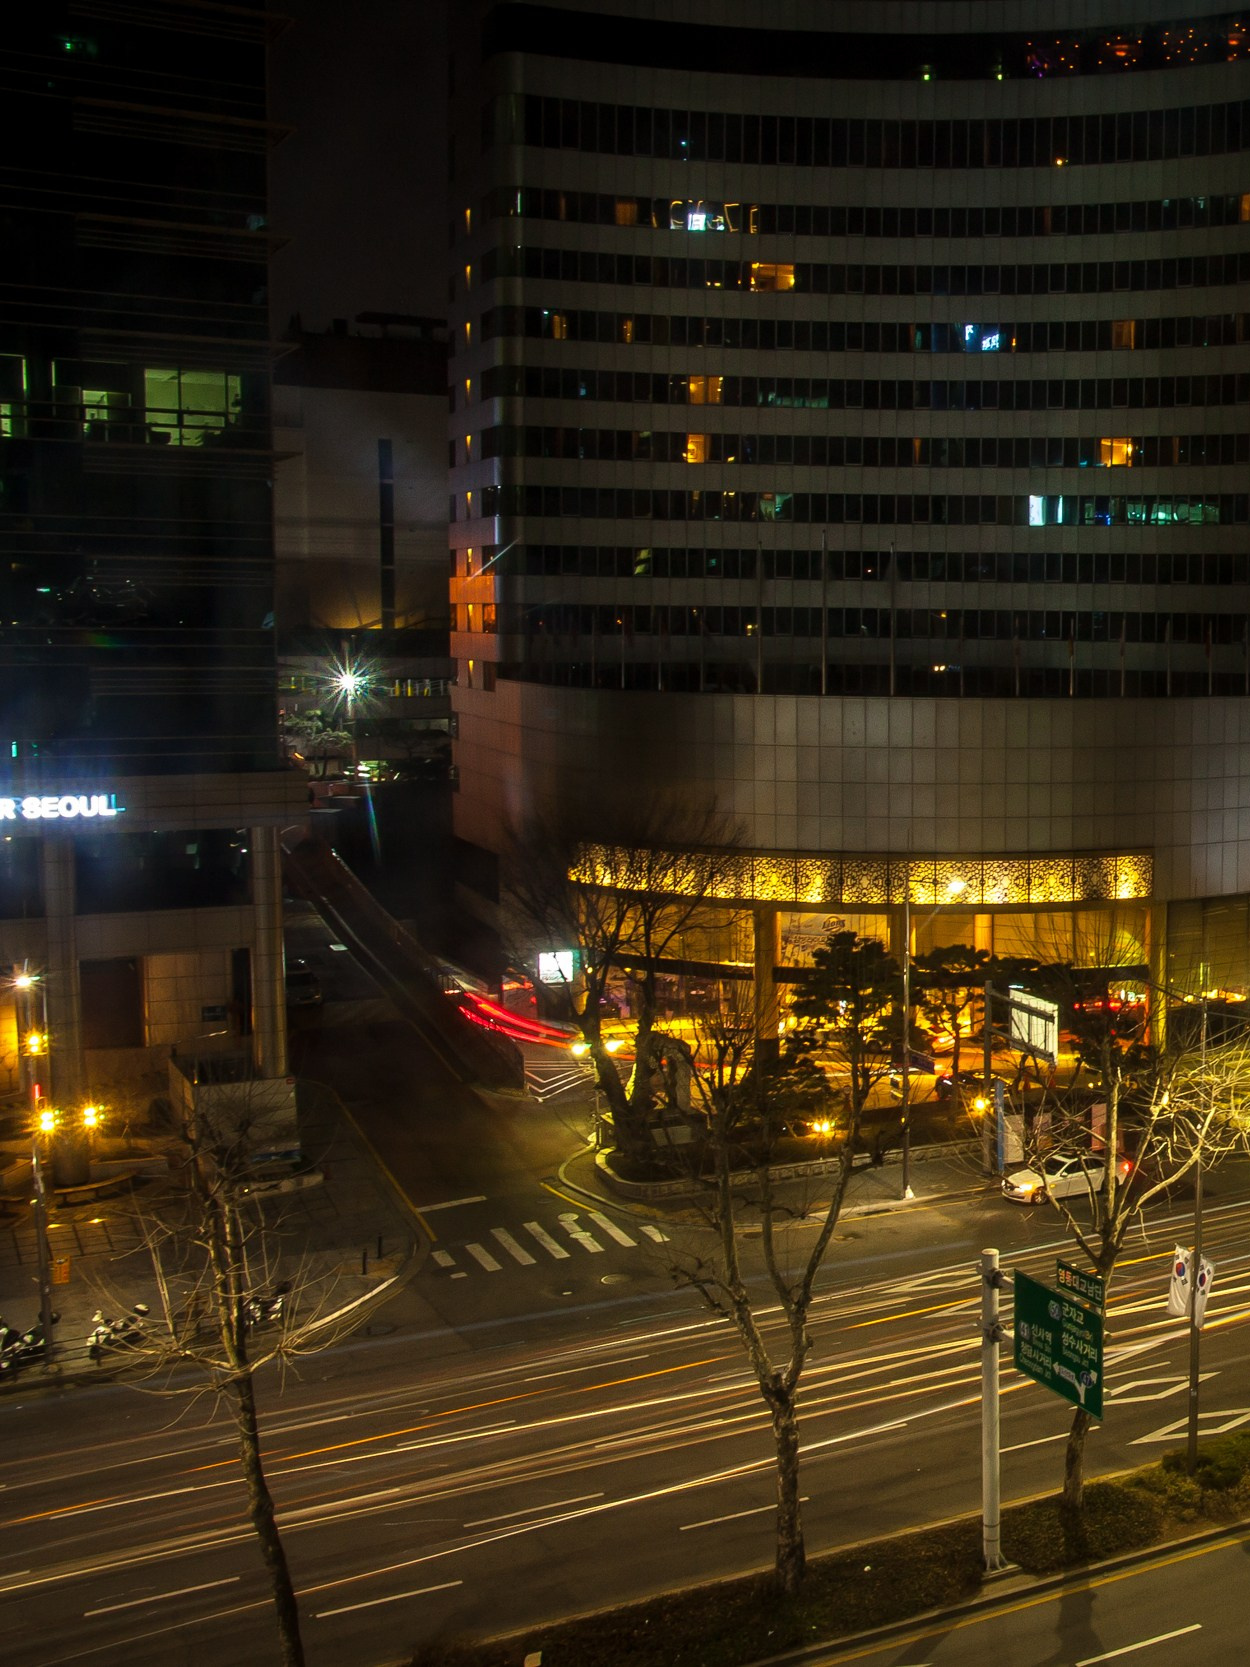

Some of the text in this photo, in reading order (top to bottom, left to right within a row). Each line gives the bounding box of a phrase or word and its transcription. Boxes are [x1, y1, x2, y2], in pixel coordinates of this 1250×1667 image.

[22, 795, 121, 819] SEOUL
[1058, 1268, 1102, 1300] 영동대교남단
[1062, 1332, 1098, 1363] 성수사거리
